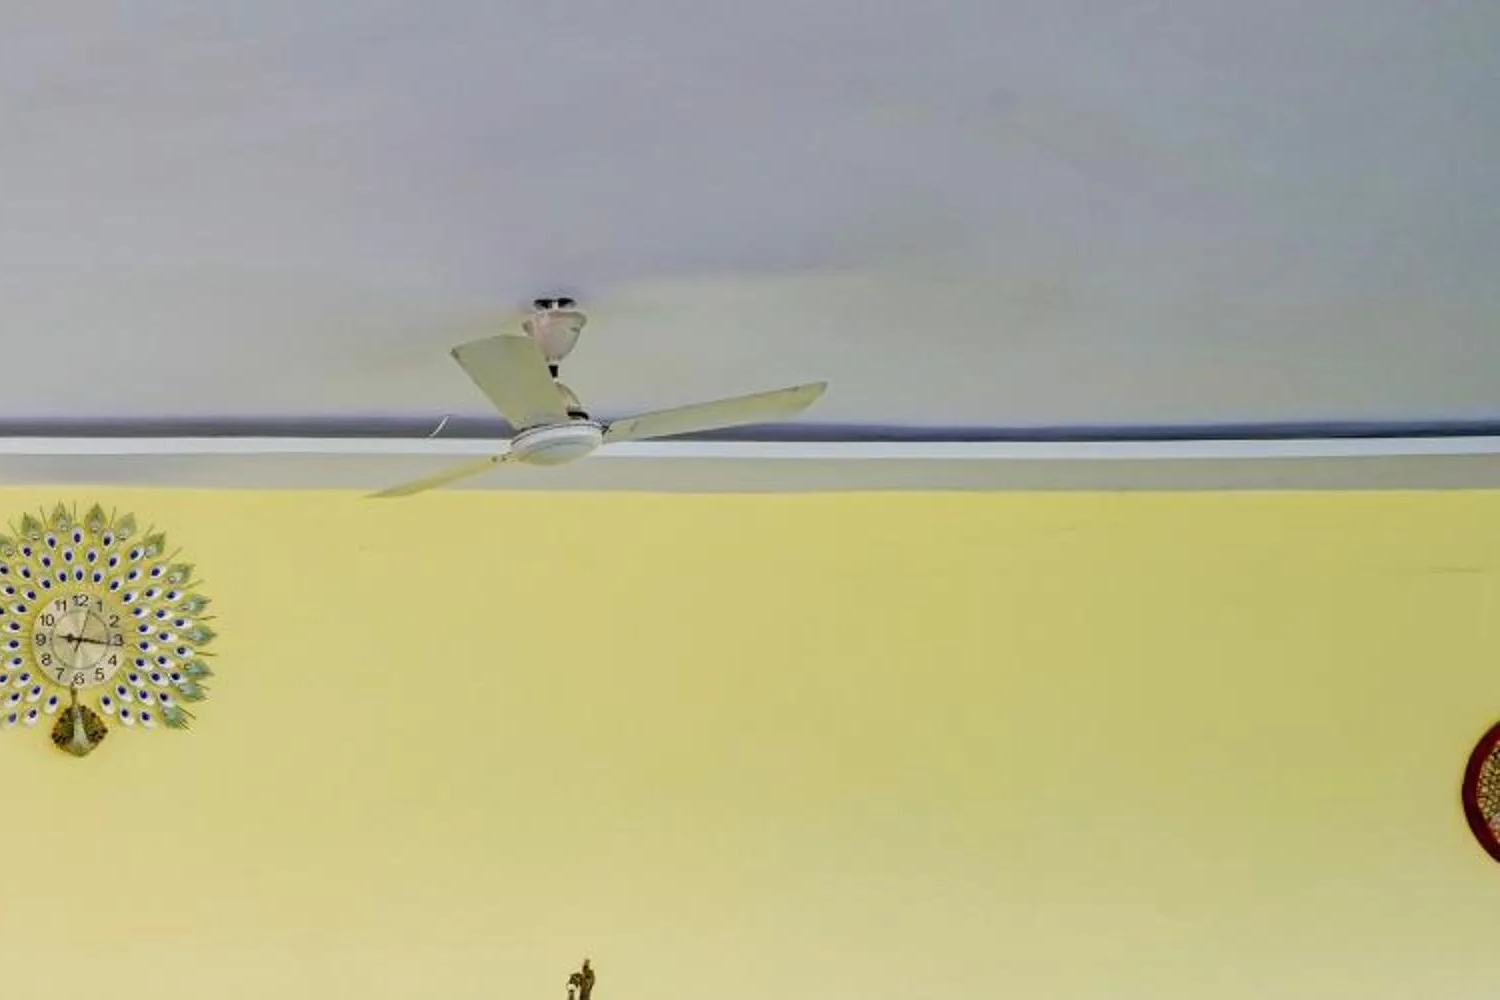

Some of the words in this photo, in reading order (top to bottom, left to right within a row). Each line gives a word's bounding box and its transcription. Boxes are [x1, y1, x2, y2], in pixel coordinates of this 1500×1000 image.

[54, 600, 67, 612] 11
[72, 594, 89, 607] 12
[96, 599, 103, 613] 1
[40, 614, 55, 627] 10
[109, 614, 120, 628] 2
[35, 633, 47, 647] 9
[113, 633, 124, 647] 3
[41, 653, 52, 666] 8
[108, 654, 117, 666] 4
[56, 667, 65, 681] 7
[73, 672, 85, 685] 6
[95, 667, 105, 681] 5
